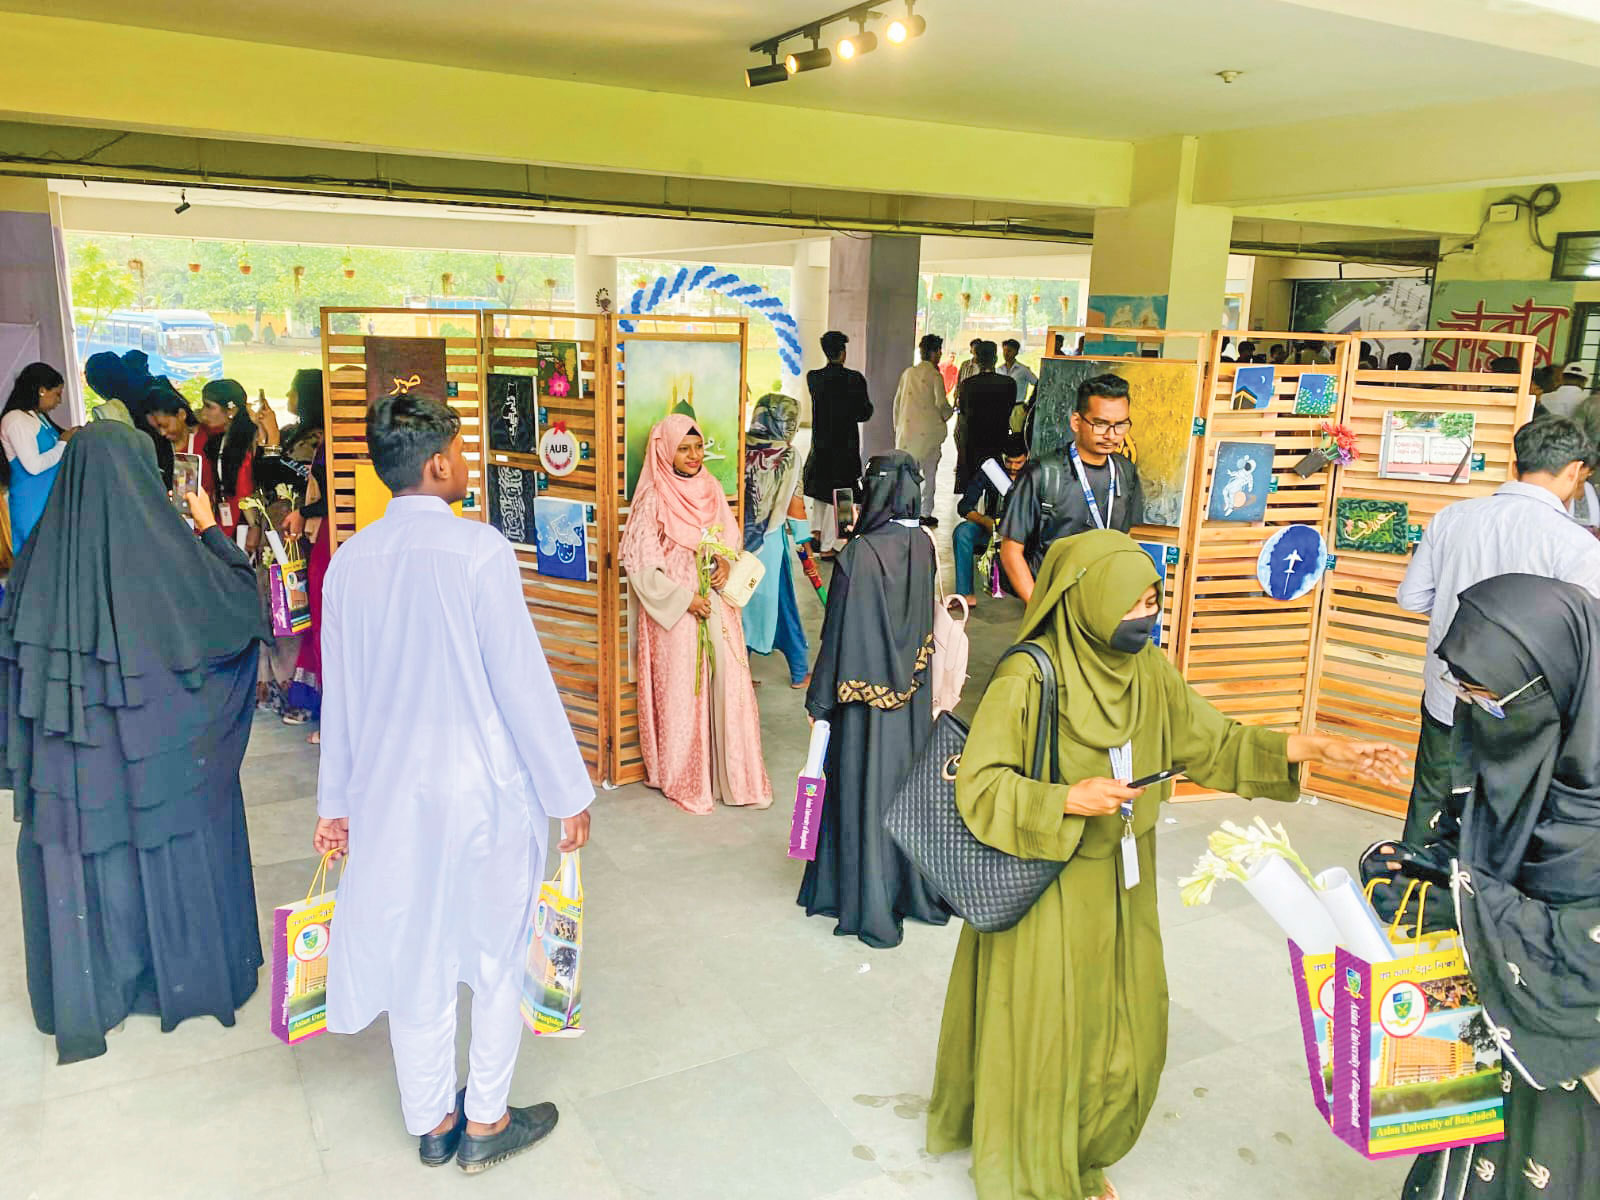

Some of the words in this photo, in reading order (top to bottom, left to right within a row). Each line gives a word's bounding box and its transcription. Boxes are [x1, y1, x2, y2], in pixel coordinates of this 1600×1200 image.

[549, 444, 569, 454] AUB
[1350, 1000, 1361, 1025] Asian
[1348, 1026, 1361, 1069] University
[1349, 1079, 1361, 1128] Bangladesh
[1376, 1125, 1400, 1137] Asian
[1402, 1119, 1442, 1133] University
[1444, 1117, 1453, 1126] of
[1454, 1109, 1497, 1125] Bangladesh
